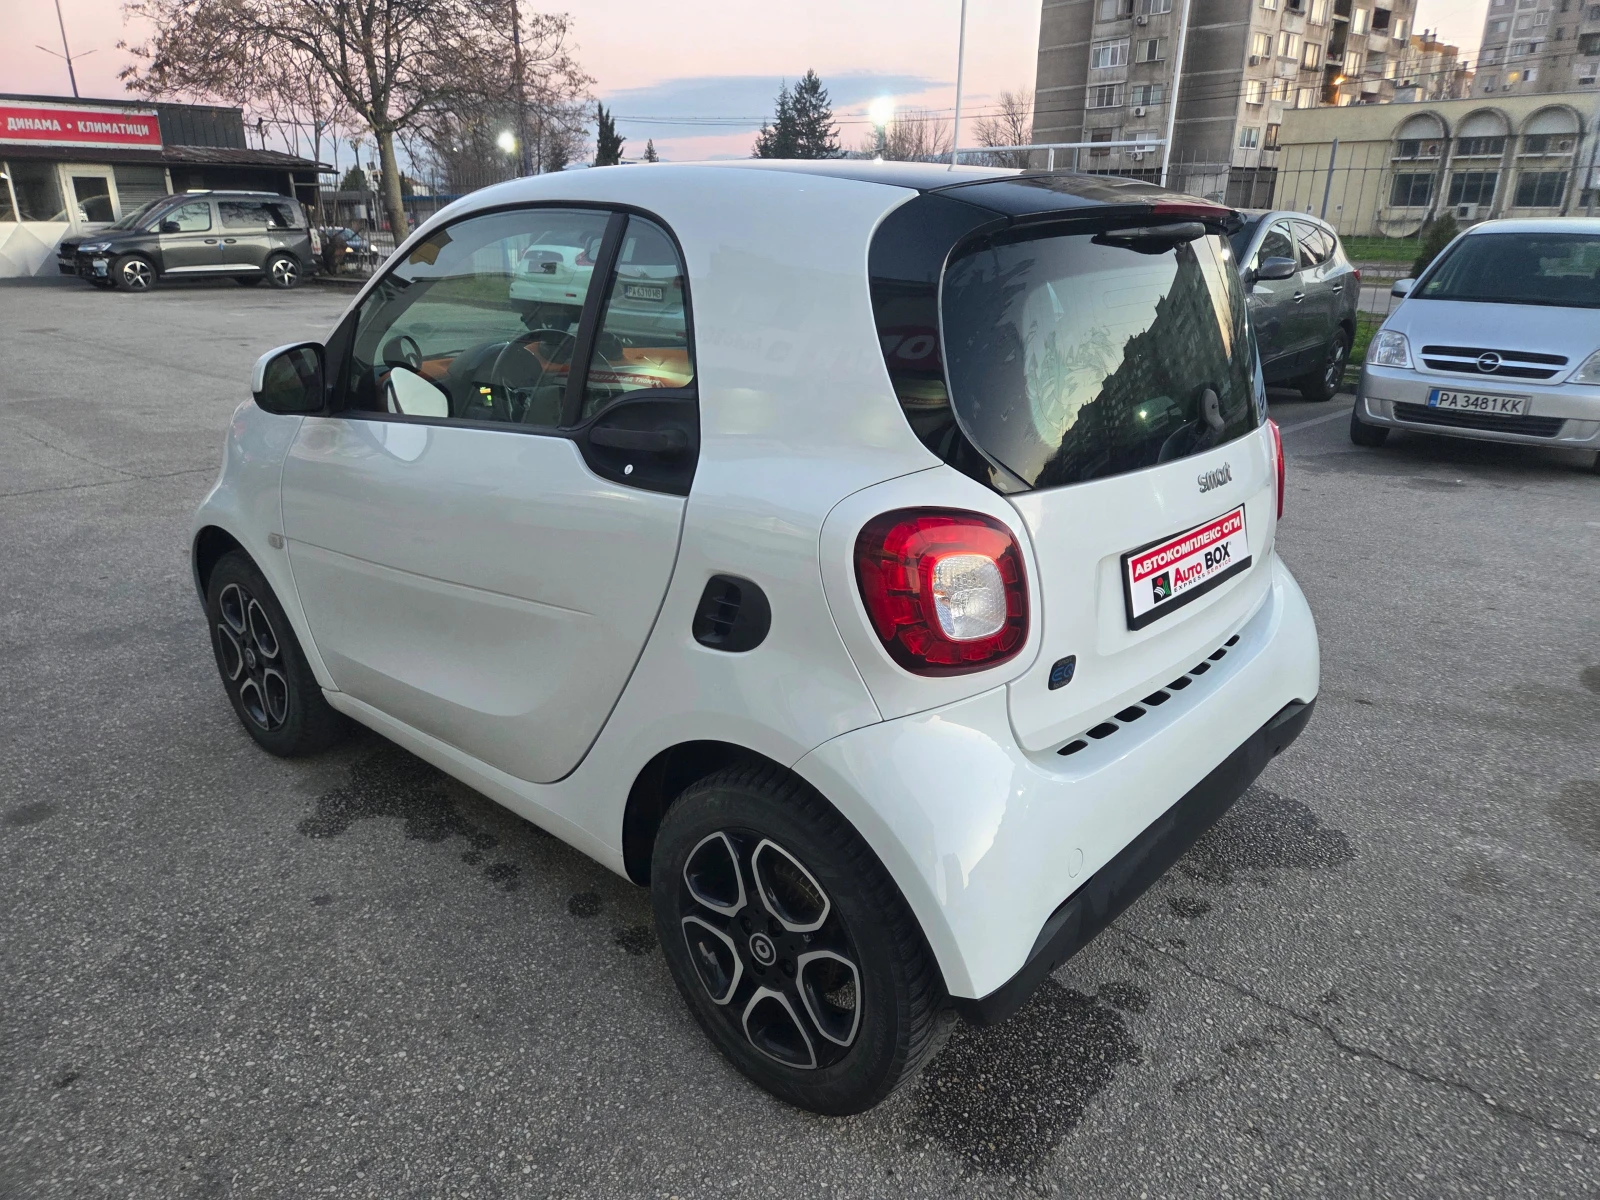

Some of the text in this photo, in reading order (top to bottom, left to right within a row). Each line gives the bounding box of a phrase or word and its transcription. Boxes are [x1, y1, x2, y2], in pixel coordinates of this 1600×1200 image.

[7, 117, 149, 137] ДИНАМА КЛИМАТИЦИ
[1439, 393, 1458, 407] PA
[1461, 395, 1497, 411] 3481
[1500, 399, 1522, 413] KK
[1135, 516, 1241, 578] АВТОКОМПЛЕКС ОГИ
[1204, 541, 1231, 570] BOX
[1174, 558, 1231, 593] EXPRESS SERVICE
[1052, 663, 1075, 682] EQ
